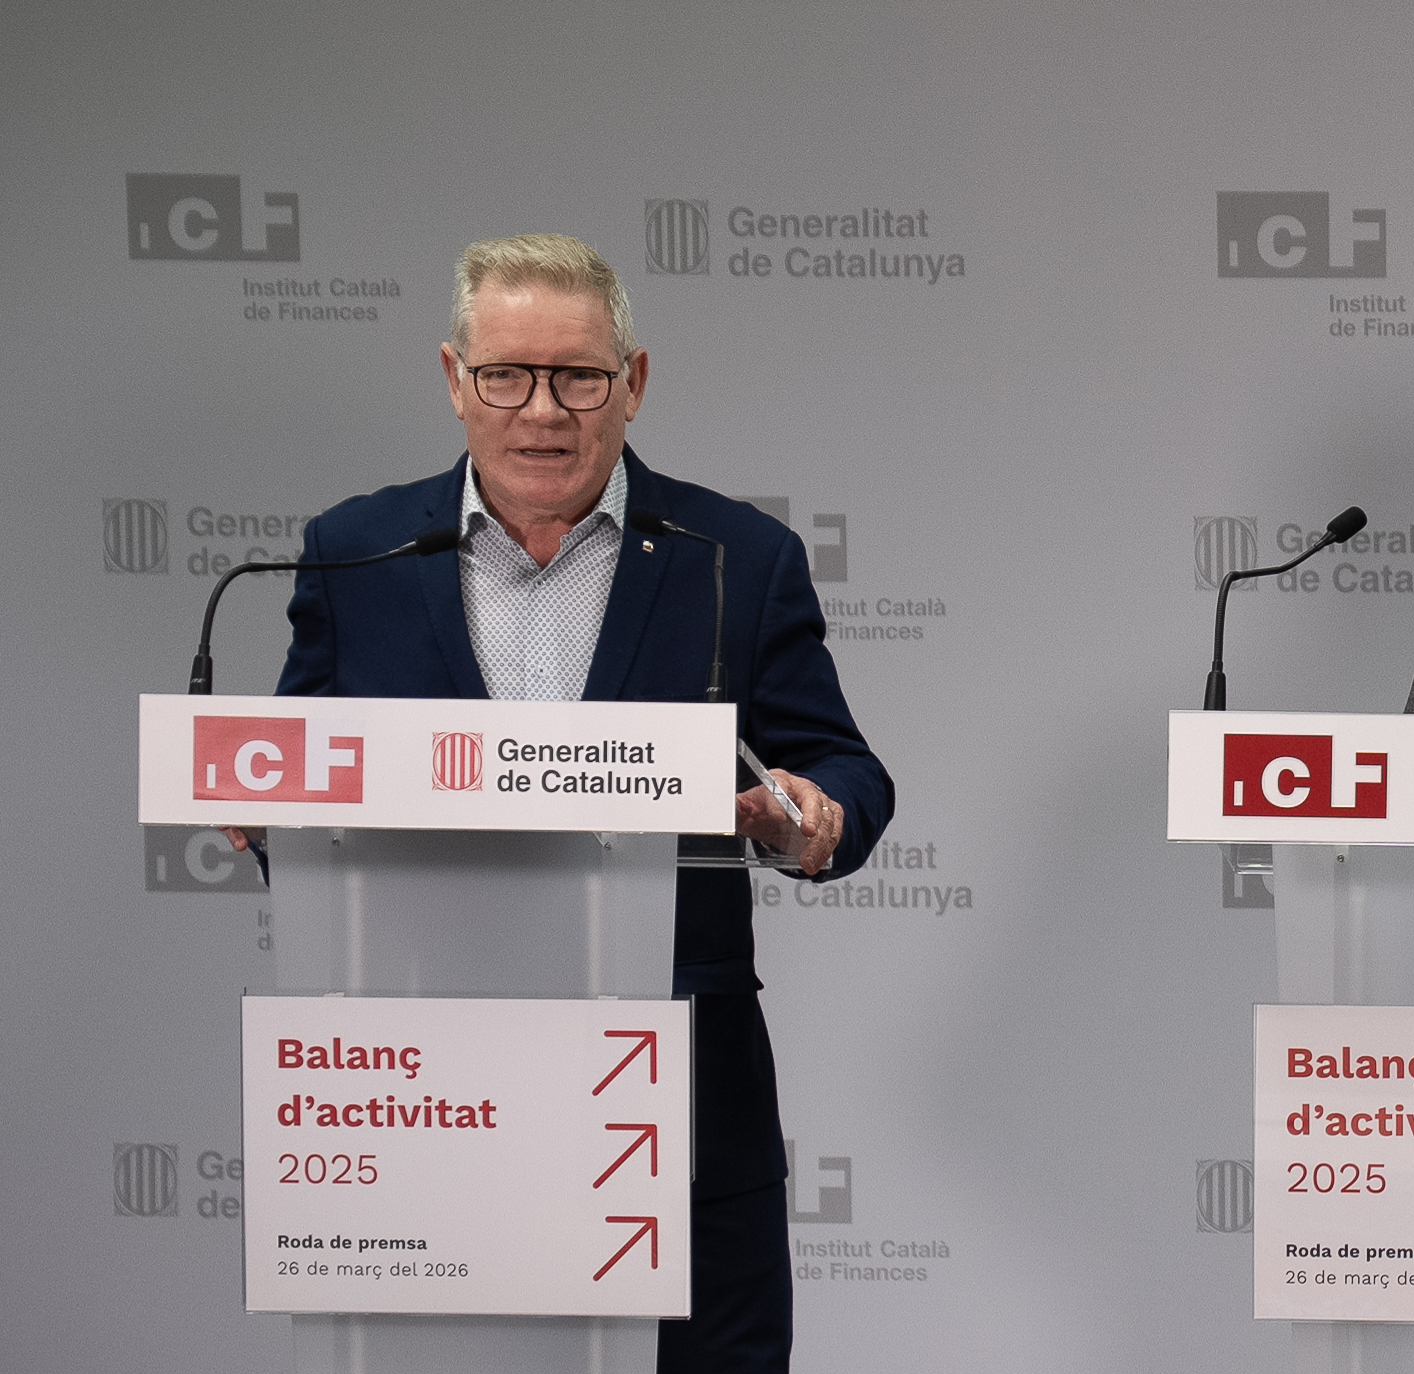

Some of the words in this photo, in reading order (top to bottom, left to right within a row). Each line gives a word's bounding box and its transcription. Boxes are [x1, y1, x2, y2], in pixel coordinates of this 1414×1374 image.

[727, 206, 928, 239] Generalitat
[728, 247, 773, 278] de
[784, 246, 966, 286] Catalunya
[242, 277, 321, 298] Institut
[329, 277, 402, 298] Català
[243, 301, 271, 322] de
[277, 301, 379, 322] Finances
[1328, 294, 1406, 314] Institut
[1328, 318, 1357, 337] de
[186, 505, 313, 537] Gener
[186, 544, 230, 577] de
[1276, 568, 1320, 592] de
[821, 598, 867, 617] titut
[875, 597, 947, 617] Català
[827, 621, 924, 640] Finances
[206, 716, 366, 792] ICF
[497, 738, 655, 764] Generalitat
[1234, 734, 1386, 808] ICF
[497, 769, 531, 793] de
[541, 769, 682, 801] Catalunya
[794, 878, 973, 916] Catalunya
[277, 1037, 422, 1080] Balanç
[278, 1153, 378, 1185] 2025
[1287, 1162, 1386, 1194] 2025
[277, 1234, 324, 1249] Roda
[329, 1234, 352, 1250] de
[358, 1238, 428, 1254] premsa
[795, 1238, 872, 1258] Institut
[879, 1239, 951, 1259] Català
[1286, 1243, 1332, 1258] Roda
[1337, 1243, 1360, 1259] de
[277, 1260, 300, 1276] 26
[306, 1260, 329, 1276] de
[336, 1264, 382, 1281] març
[389, 1261, 418, 1277] del
[424, 1262, 469, 1278] 2026
[795, 1262, 823, 1281] de
[829, 1261, 928, 1282] Finances
[1285, 1269, 1308, 1285] 26
[1314, 1269, 1337, 1285] de
[1344, 1273, 1390, 1290] març
